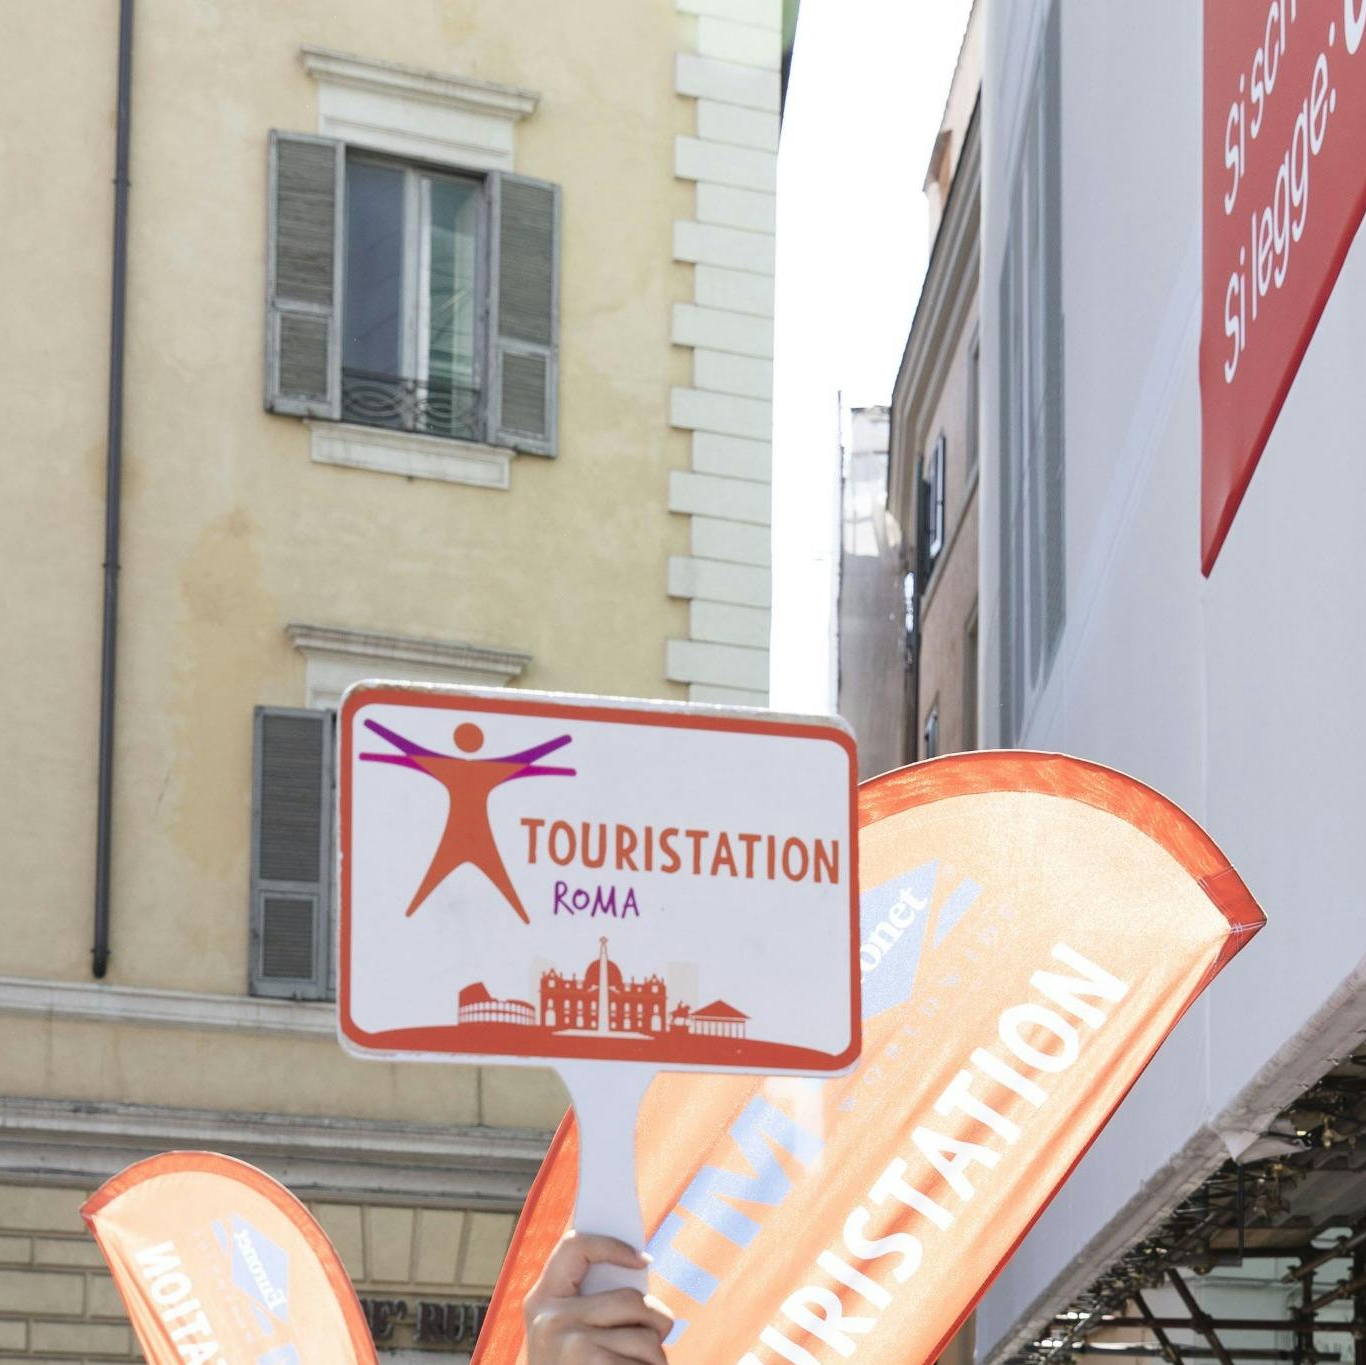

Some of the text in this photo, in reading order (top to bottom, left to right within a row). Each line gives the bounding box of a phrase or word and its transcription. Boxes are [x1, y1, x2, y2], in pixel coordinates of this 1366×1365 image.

[1224, 73, 1246, 215] si
[1224, 246, 1246, 384] si
[520, 817, 840, 884] TOURISTATION
[553, 880, 640, 919] ROMA
